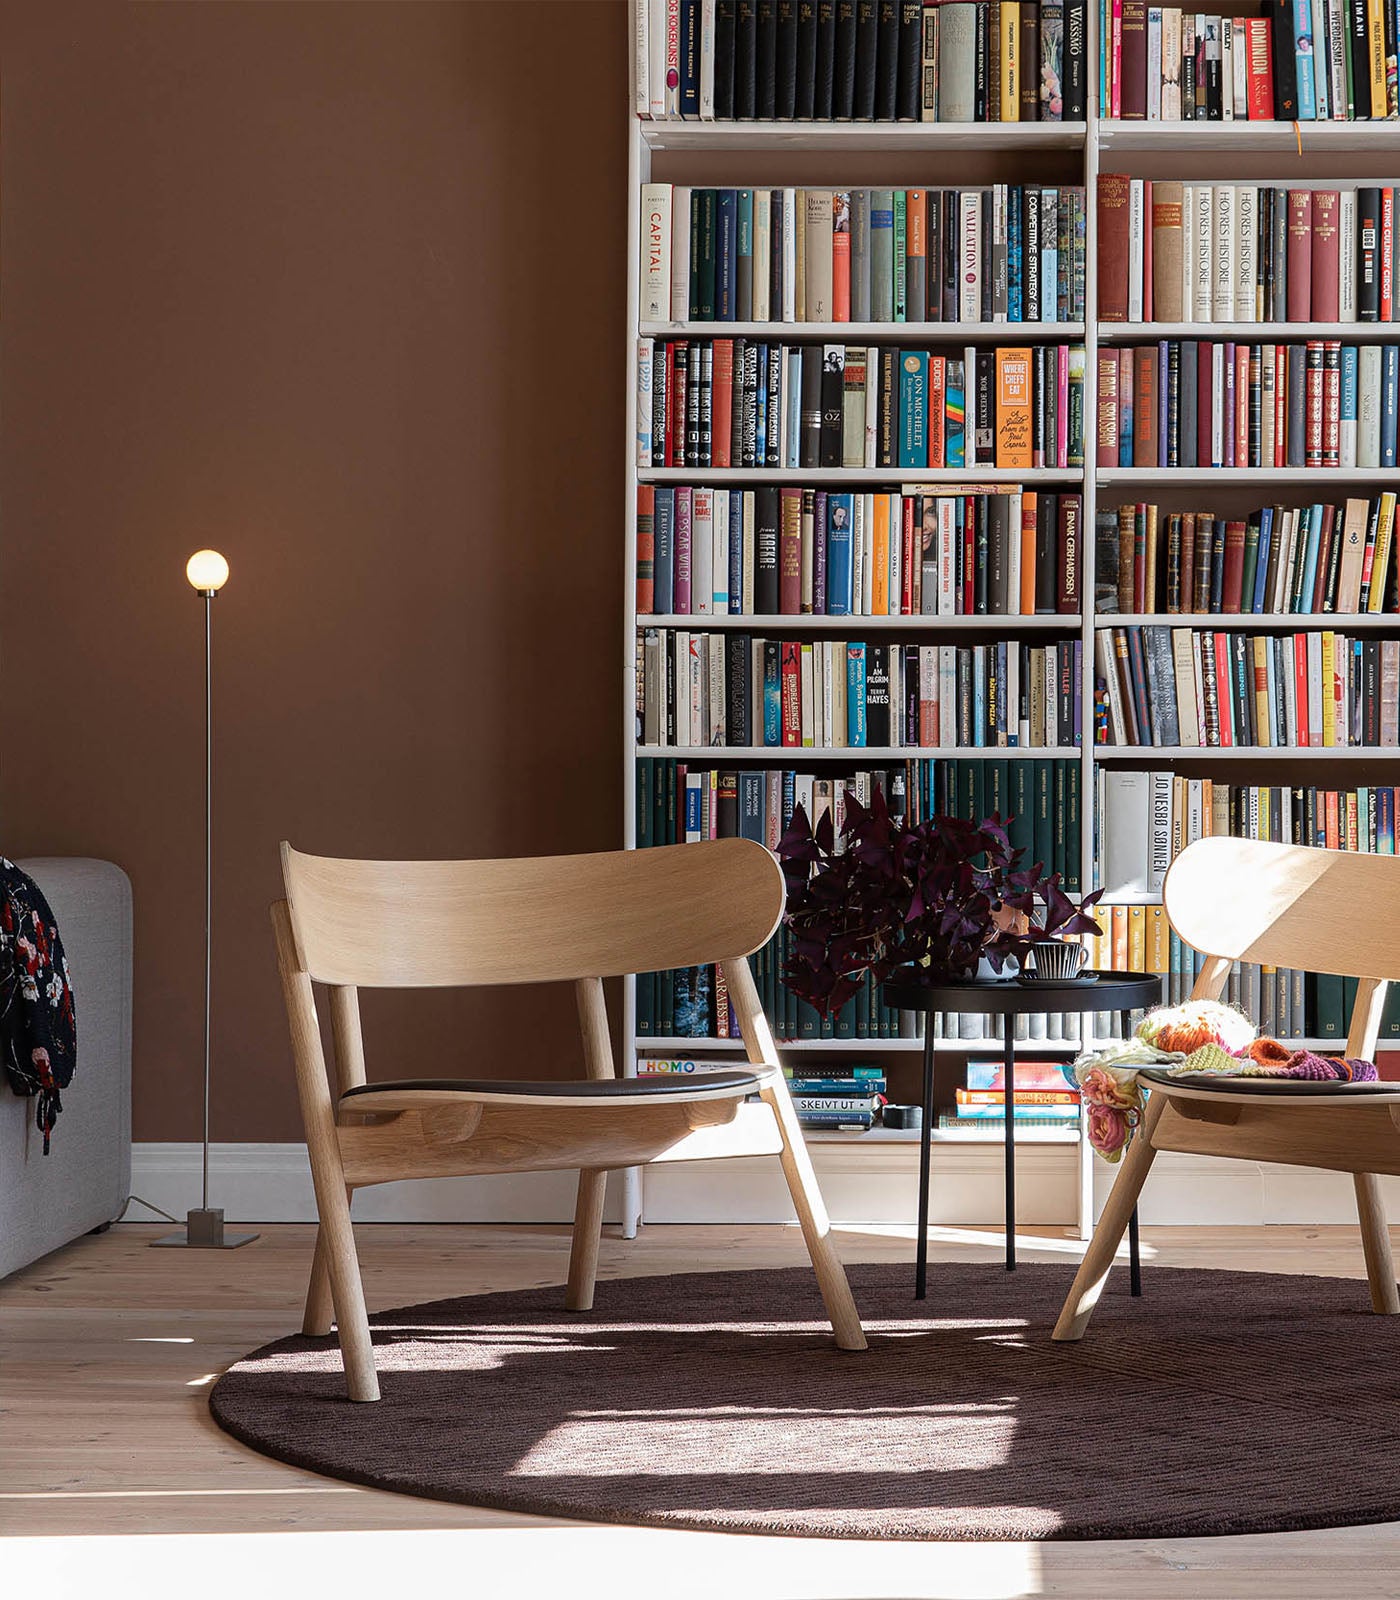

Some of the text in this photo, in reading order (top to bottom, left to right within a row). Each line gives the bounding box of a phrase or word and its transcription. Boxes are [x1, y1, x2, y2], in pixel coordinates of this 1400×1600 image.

[666, 15, 680, 67] KOKEKUNST
[1224, 23, 1232, 50] HUXLEY
[1251, 20, 1268, 75] DOMINION
[1331, 11, 1343, 67] HVERDAGSMAT
[649, 213, 662, 274] CAPITAL
[966, 210, 977, 270] VALUATION
[1028, 196, 1038, 301] COMPETITIVE STRATEGY
[1199, 192, 1211, 286] HØYRES HISTORIE
[1219, 192, 1231, 286] HØYRES HISTORIE
[1240, 192, 1253, 286] HØYRES HISTORIE
[1363, 230, 1374, 249] LOGO
[1383, 199, 1392, 300] FLYING CULINARY CIRCUS
[639, 360, 651, 393] 1222
[1003, 363, 1025, 374] WHERE
[1005, 374, 1025, 384] CHEFS
[1009, 384, 1020, 395] EAT
[1345, 353, 1354, 417] KÅRE WILLOCH
[749, 391, 757, 452] PALINDROME
[769, 349, 779, 448] Ed McBain VUGGESANG
[913, 374, 923, 448] JON MICHELET
[933, 359, 942, 464] DUDEN Was bedeutet das?
[1099, 359, 1116, 447] JOHN IRVING SIRKUSBARN
[783, 496, 801, 539] ARAFAT
[1066, 511, 1076, 574] EINAR GERHARDSEN
[679, 518, 690, 581] OSCAR WILDE
[760, 534, 776, 564] KAFKA
[732, 640, 744, 729] TJUVHOLMEN
[788, 673, 800, 731] HUNDREÅRINGEN
[867, 676, 889, 684] PILGRIM
[867, 695, 889, 704] HAYES
[925, 682, 933, 709] Bryson
[1062, 668, 1070, 694] TILLER
[1153, 776, 1169, 873] JO NESBØ SØNNEN
[716, 975, 729, 1018] ARABS
[646, 1061, 695, 1074] HOMO
[800, 1100, 855, 1110] SKEIVT UT
